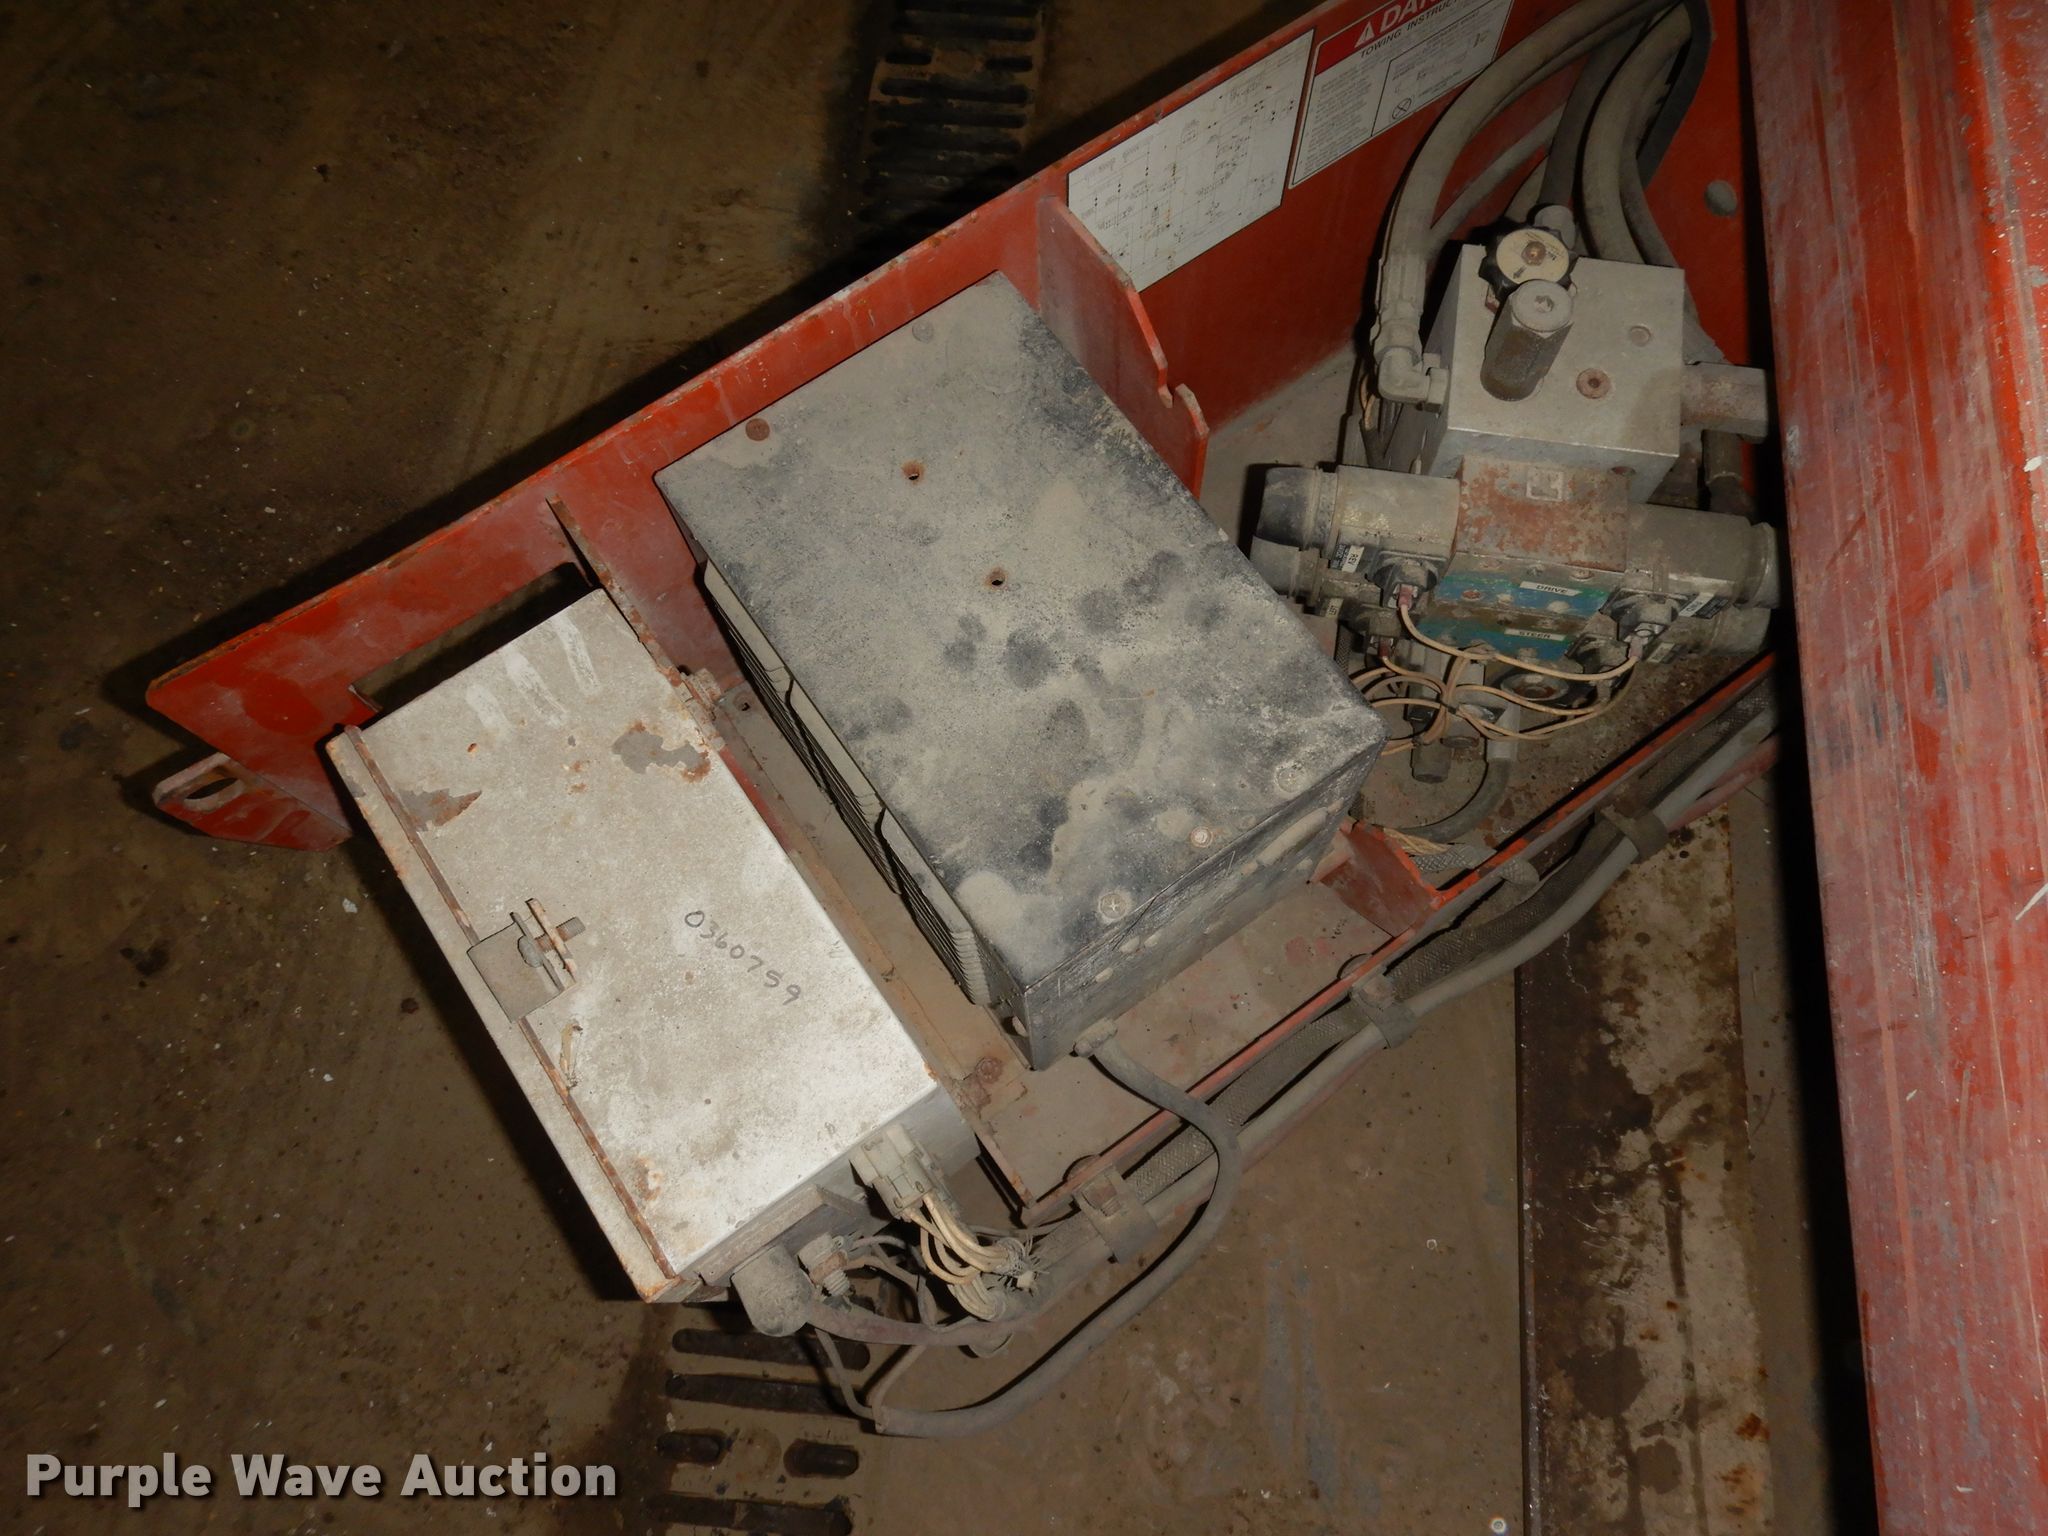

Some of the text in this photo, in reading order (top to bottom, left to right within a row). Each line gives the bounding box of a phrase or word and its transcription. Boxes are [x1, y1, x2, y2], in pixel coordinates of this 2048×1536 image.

[1361, 30, 1401, 58] TOWING
[1406, 0, 1458, 31] INSTRUC
[1379, 0, 1437, 34] DA
[1535, 583, 1568, 594] DRIVE
[1519, 630, 1552, 639] STEER
[684, 910, 801, 1006] 0360759
